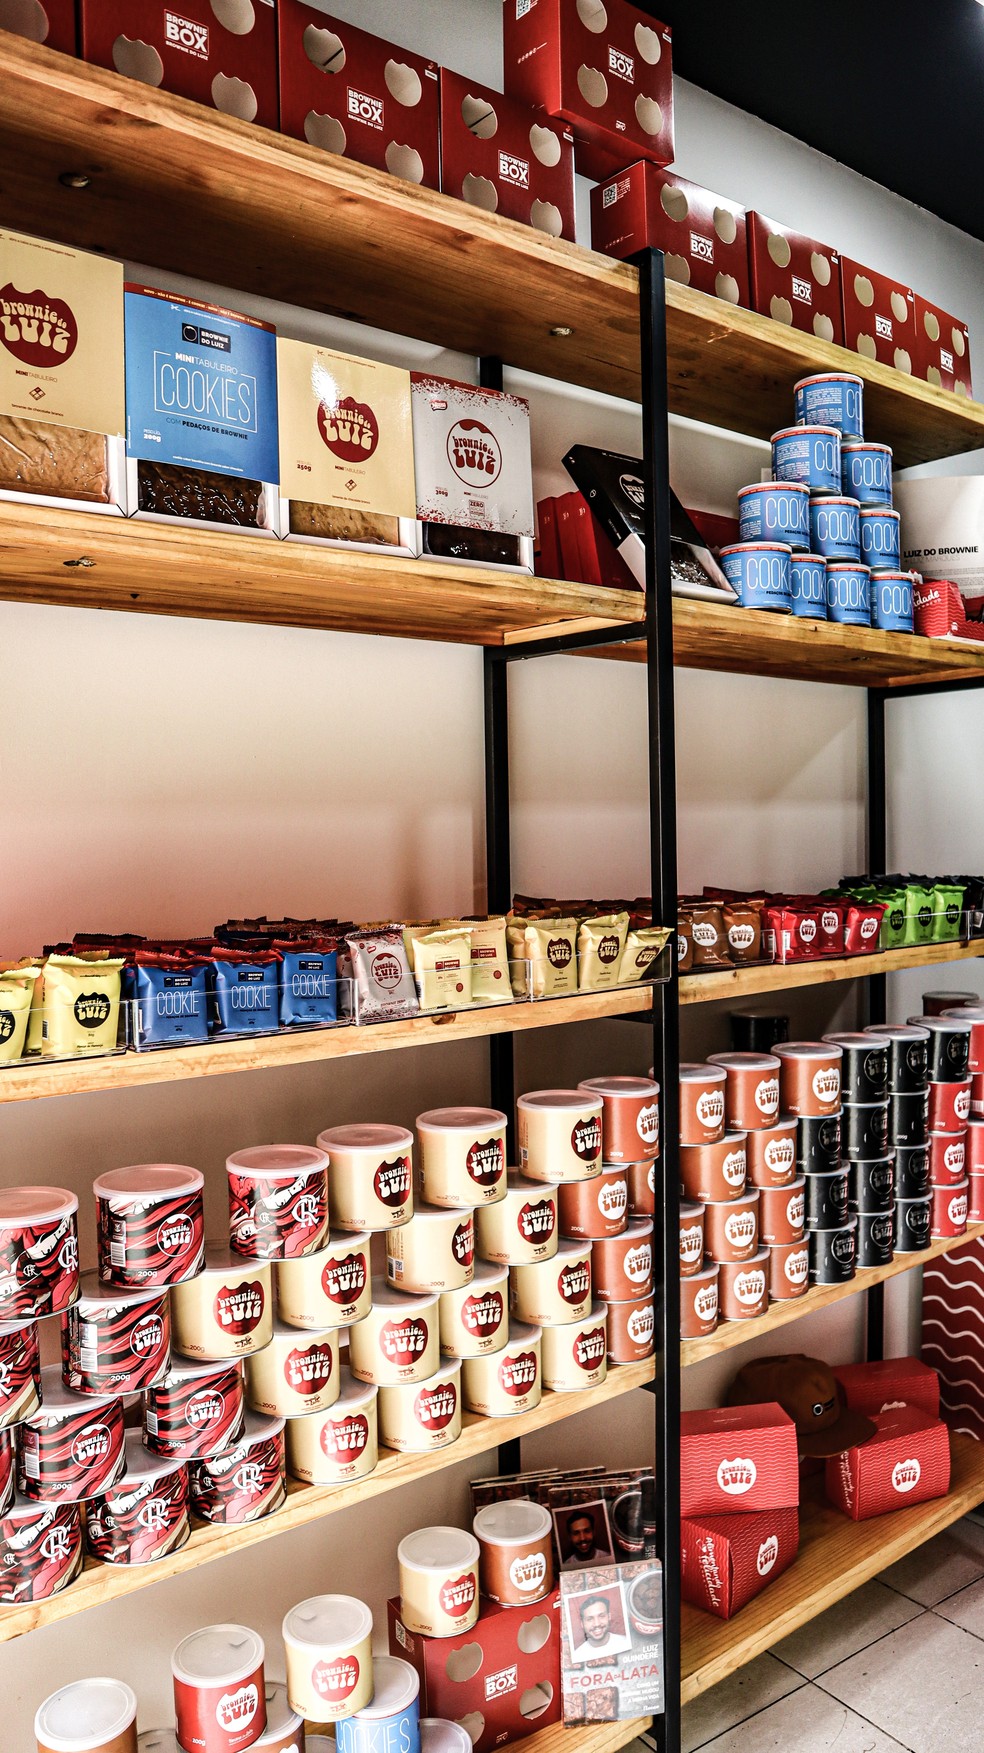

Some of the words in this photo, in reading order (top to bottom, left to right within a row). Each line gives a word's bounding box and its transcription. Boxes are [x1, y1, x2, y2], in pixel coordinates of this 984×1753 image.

[166, 12, 208, 36] BROWNIE
[165, 21, 208, 53] BOX
[166, 40, 190, 54] BROWNIE
[198, 51, 209, 61] LUIZ
[609, 55, 634, 78] BOX
[348, 89, 383, 110] BROWNIE
[348, 100, 383, 124] BOX
[499, 153, 529, 170] BROWNIE
[499, 162, 528, 183] BOX
[690, 240, 713, 259] BOX
[792, 284, 811, 301] BOX
[0, 299, 58, 324] brownie
[57, 317, 67, 328] do
[0, 316, 71, 354] LUIZ
[201, 331, 229, 344] BROWNIE
[875, 321, 892, 337] BOX
[211, 340, 225, 349] LUIZ
[175, 352, 239, 376] MINITABULEIRO
[160, 363, 251, 424] COOKIES
[143, 433, 162, 443] 200g
[166, 417, 182, 426] COM
[182, 420, 211, 432] PEDAÇOS
[212, 427, 220, 435] DE
[220, 428, 249, 441] BROWNIE
[322, 419, 374, 451] LUIZ
[452, 436, 488, 453] brownie
[297, 464, 312, 472] 250g
[452, 448, 496, 475] LUIZ
[903, 549, 922, 559] LUIZ
[923, 548, 937, 557] DO
[938, 545, 979, 556] BROWNIE
[291, 973, 331, 997] COOKIE
[156, 989, 200, 1016] COOKIE
[231, 984, 272, 1010] COOKIE
[77, 1006, 108, 1020] LUIZ
[471, 1144, 499, 1161] brownie
[769, 1150, 793, 1165] LUIZ
[471, 1155, 504, 1177] LUIZ
[378, 1174, 410, 1198] LUIZ
[446, 1194, 460, 1203] 200g
[350, 1217, 366, 1227] 200g
[521, 1206, 549, 1222] brownie
[521, 1215, 554, 1237] LUIZ
[571, 1225, 585, 1233] 200g
[730, 1223, 754, 1240] LUIZ
[161, 1233, 192, 1249] LUIZ
[496, 1251, 510, 1260] 200g
[137, 1270, 159, 1280] 200g
[326, 1260, 359, 1279] brownie
[326, 1270, 365, 1296] LUIZ
[430, 1279, 445, 1289] 200g
[561, 1275, 590, 1298] LUIZ
[597, 1288, 611, 1297] 200g
[739, 1282, 764, 1297] LUIZ
[218, 1288, 255, 1307] brownie
[465, 1297, 496, 1315] brownie
[218, 1299, 262, 1326] LUIZ
[298, 1313, 315, 1322] 200g
[465, 1307, 502, 1329] LUIZ
[135, 1332, 162, 1352] LUIZ
[383, 1325, 418, 1343] brownie
[190, 1343, 206, 1354] 200g
[383, 1333, 425, 1355] LUIZ
[578, 1342, 605, 1364] LUIZ
[289, 1350, 324, 1369] brownie
[110, 1373, 131, 1383] 200g
[289, 1361, 330, 1386] LUIZ
[503, 1366, 536, 1389] LUIZ
[262, 1401, 277, 1412] 200g
[418, 1389, 449, 1407] brownie
[189, 1406, 221, 1423] LUIZ
[418, 1397, 455, 1423] LUIZ
[167, 1440, 187, 1451] 200g
[325, 1429, 366, 1456] LUIZ
[76, 1444, 108, 1463] LUIZ
[51, 1482, 73, 1493] 200g
[721, 1472, 754, 1487] LUIZ
[895, 1471, 917, 1486] LUIZ
[515, 1566, 544, 1584] LUIZ
[443, 1587, 475, 1610] LUIZ
[642, 1643, 659, 1653] LUIZ
[315, 1662, 350, 1678] brownie
[569, 1671, 615, 1689] FORA
[621, 1663, 660, 1681] LATA
[316, 1670, 356, 1694] LUIZ
[486, 1673, 517, 1697] BOX
[221, 1692, 250, 1712] brownie
[221, 1697, 256, 1726] LUIZ
[191, 1736, 207, 1747] 200g
